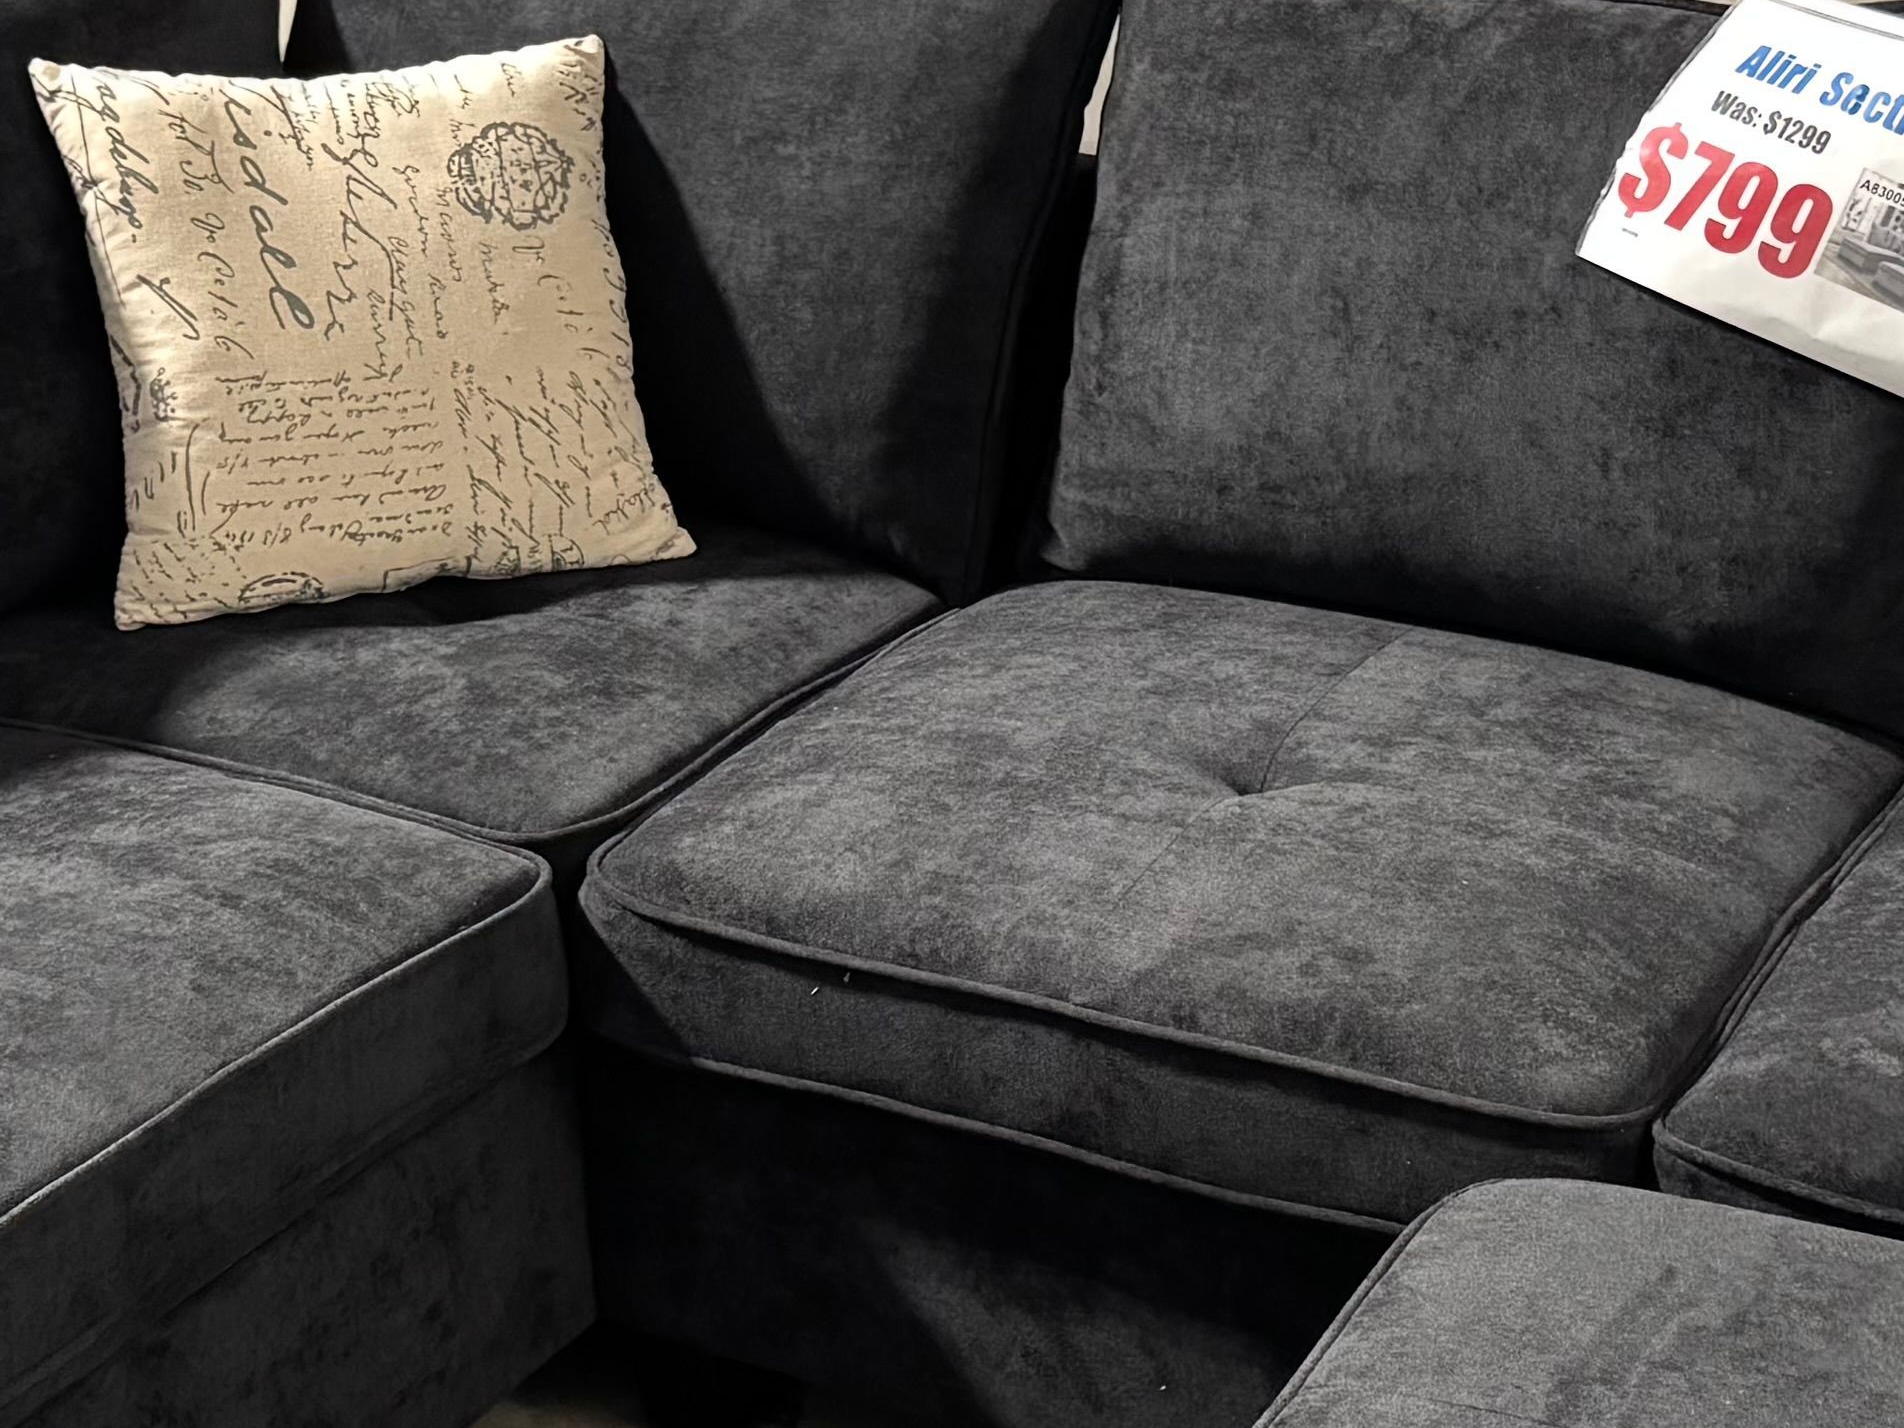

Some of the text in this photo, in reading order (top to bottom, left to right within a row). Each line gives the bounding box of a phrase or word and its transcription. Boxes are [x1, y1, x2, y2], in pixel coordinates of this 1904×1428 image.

[1734, 44, 1822, 95] Aliri
[1710, 90, 1832, 156] Was: $1299
[1617, 121, 1834, 279] $799
